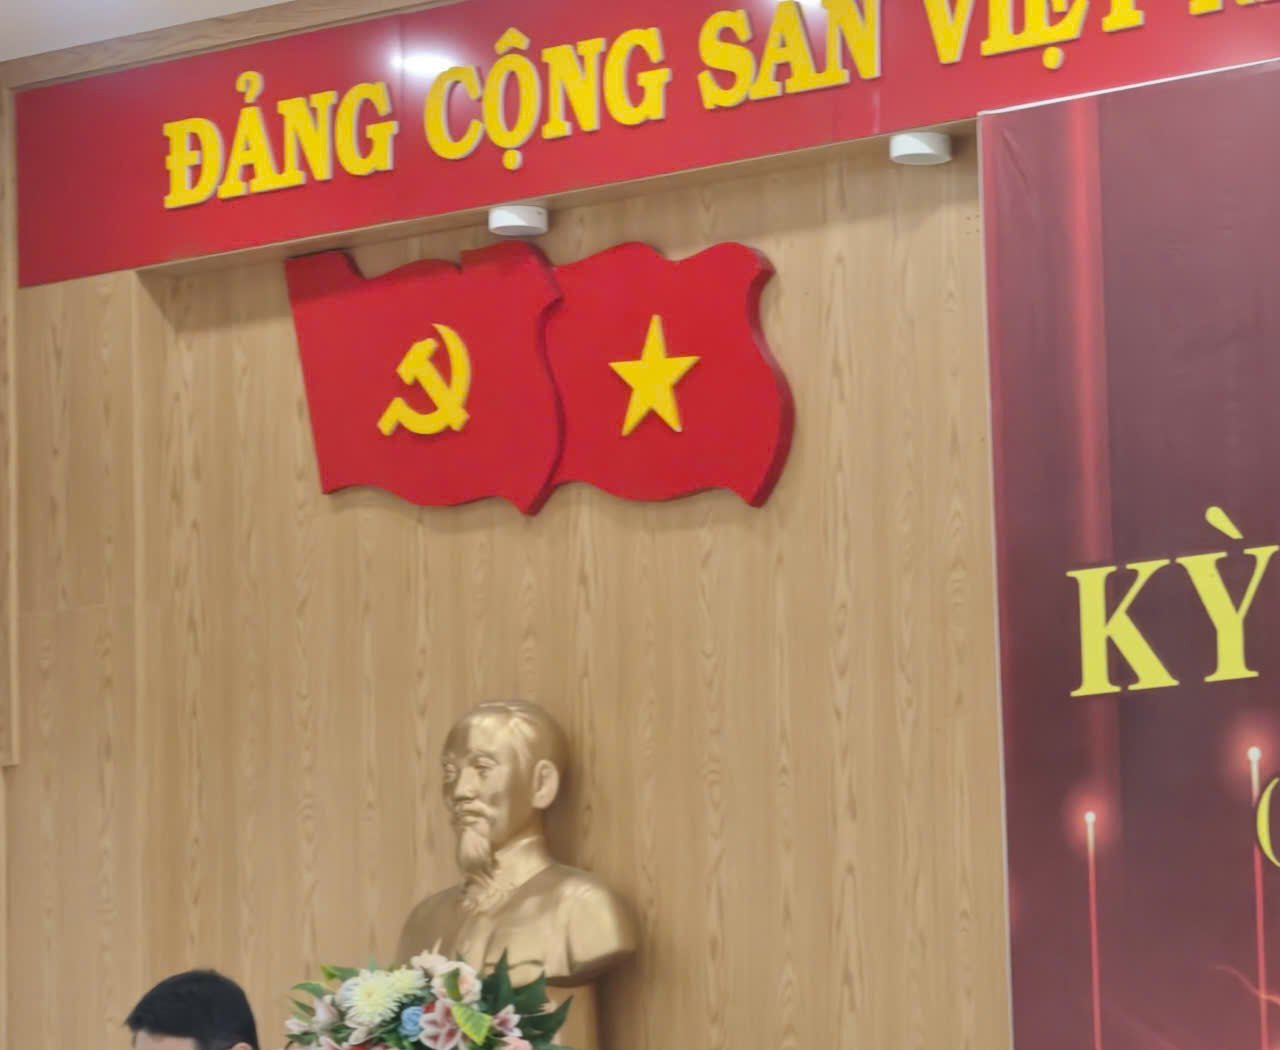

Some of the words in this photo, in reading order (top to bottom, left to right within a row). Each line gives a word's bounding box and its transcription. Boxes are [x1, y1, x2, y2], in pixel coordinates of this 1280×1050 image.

[163, 71, 398, 208] ĐẢNG
[424, 27, 671, 170] CỘNG
[1064, 505, 1280, 698] KỲ
